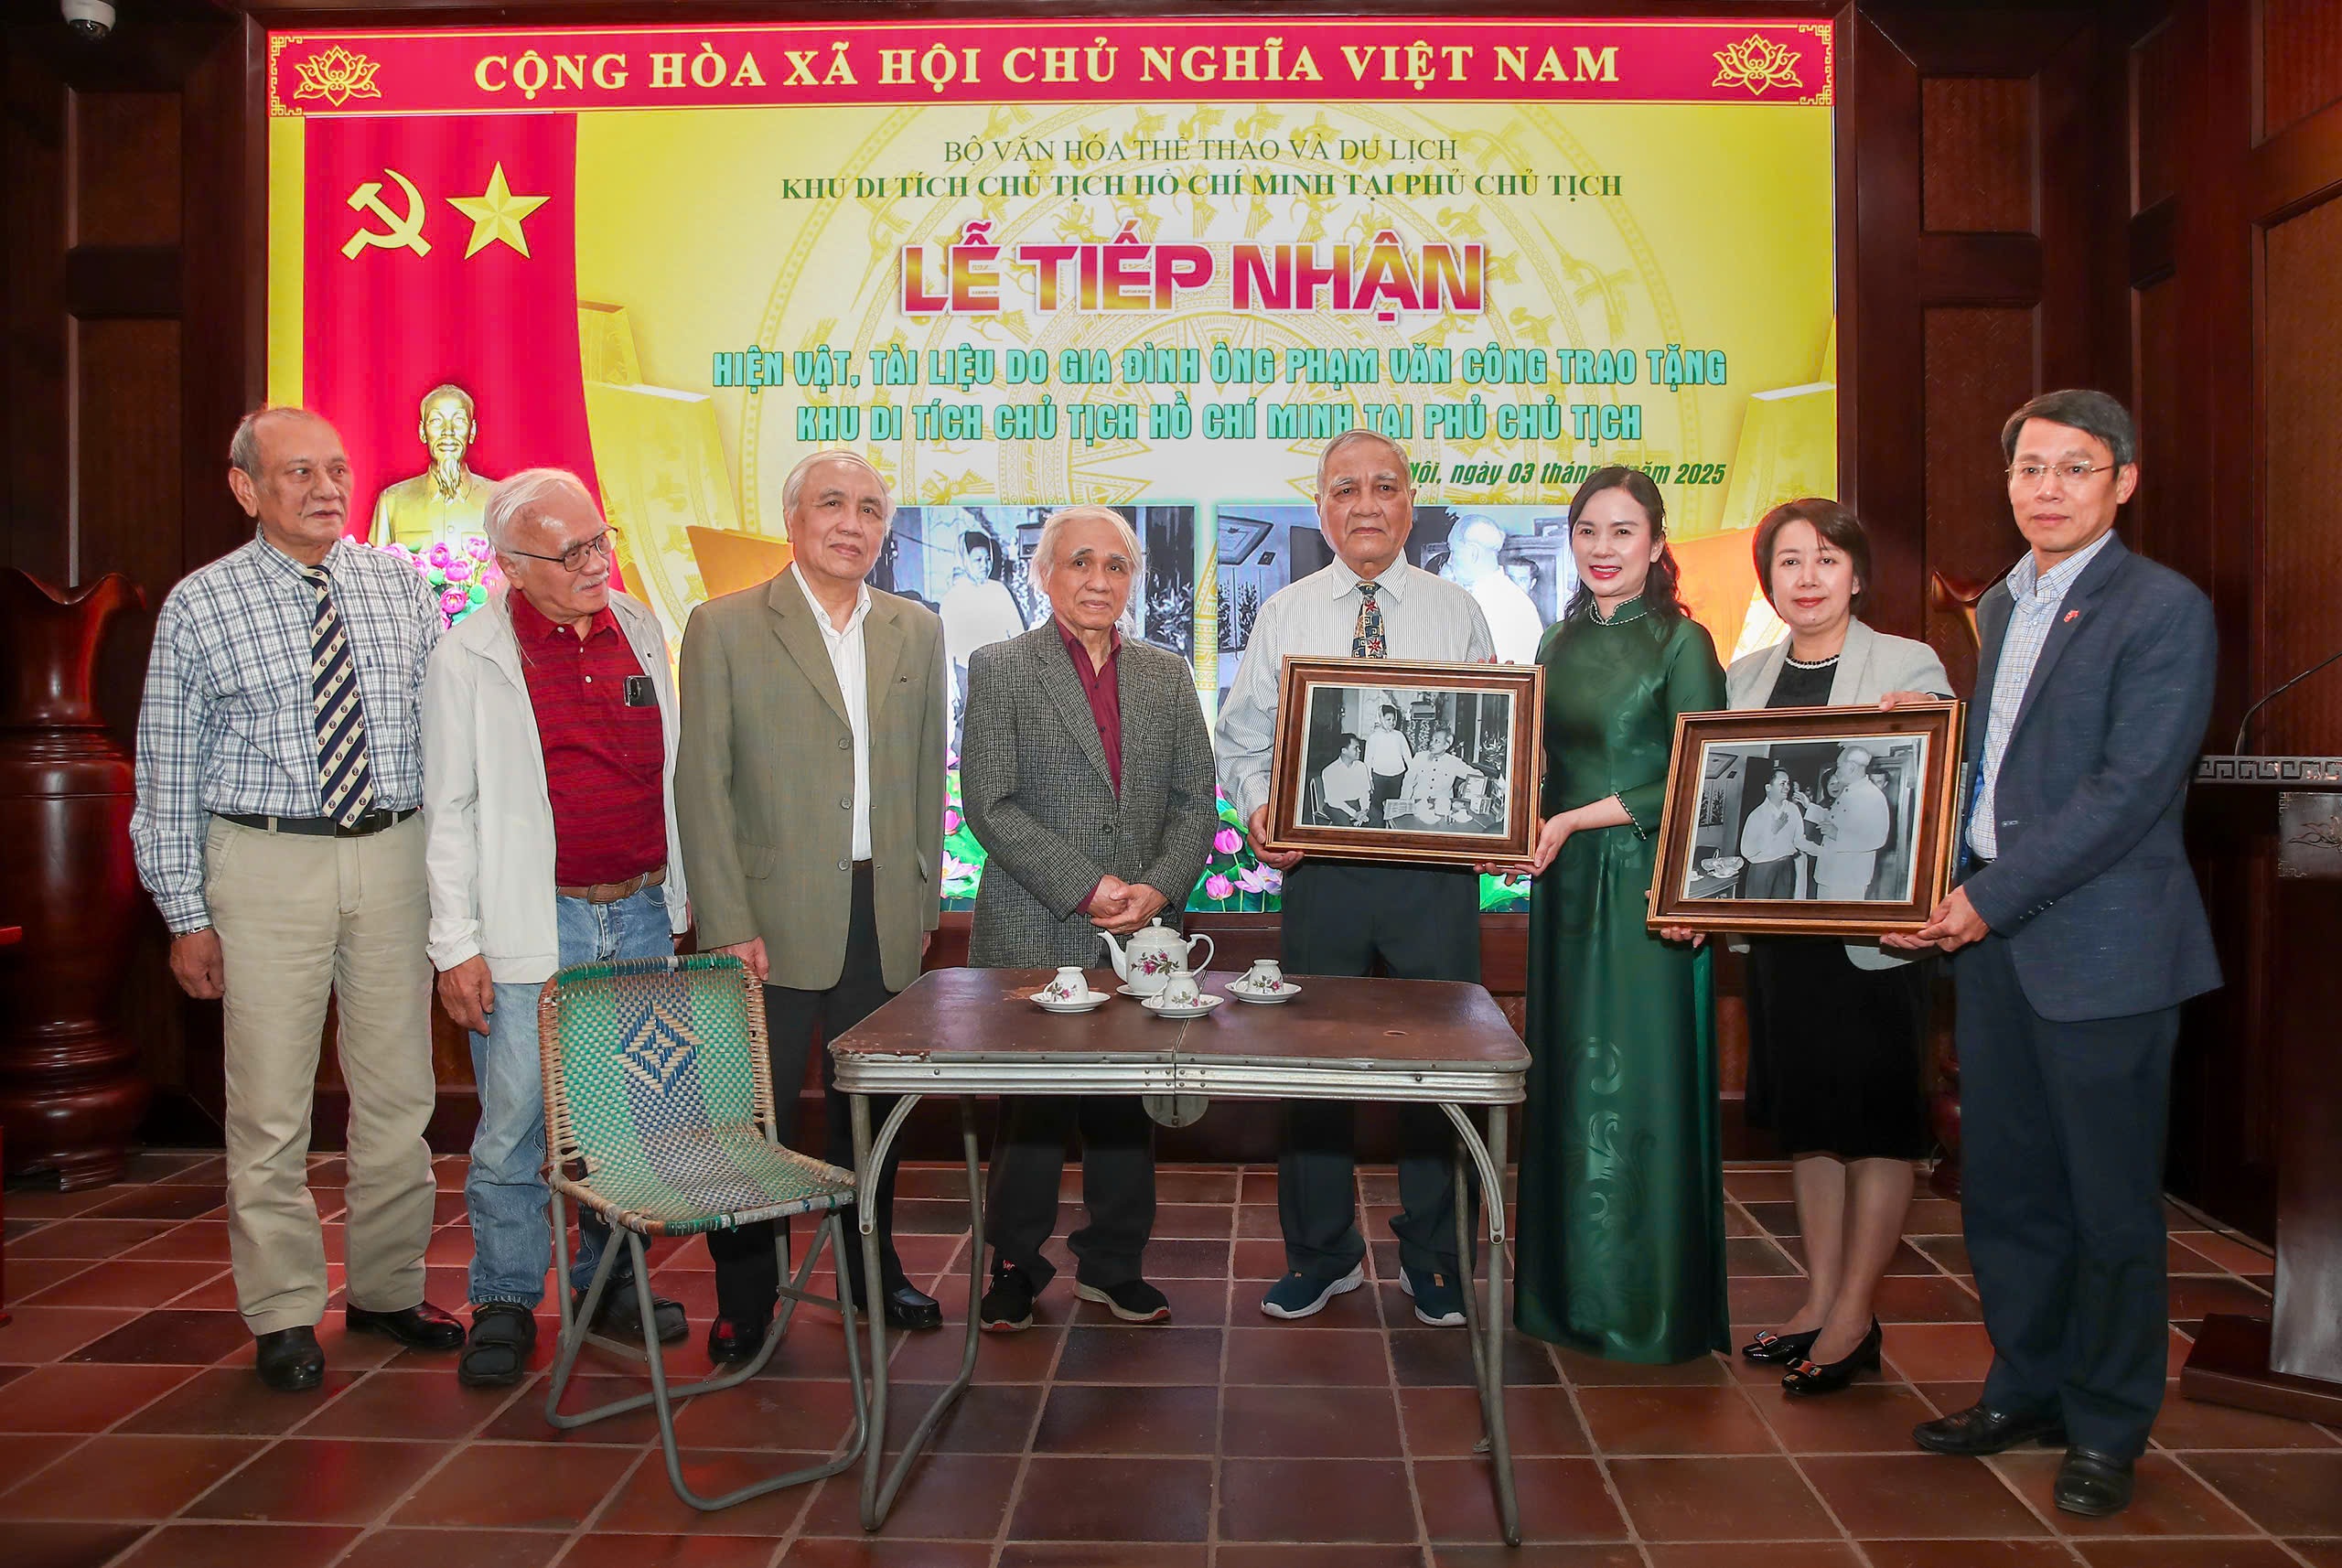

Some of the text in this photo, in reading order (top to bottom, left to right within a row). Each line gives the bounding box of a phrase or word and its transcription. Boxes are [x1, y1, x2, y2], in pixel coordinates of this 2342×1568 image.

[474, 37, 1620, 101] CỘNG HÒA XÃ HỘI CHỦ NGHĨA VIỆT NAM
[944, 134, 983, 166] BỘ
[993, 134, 1054, 162] VĂN
[1064, 134, 1127, 161] HÓA
[1198, 139, 1280, 161] THAO
[1289, 134, 1330, 161] VÀ
[1338, 139, 1380, 161] DU
[1389, 139, 1457, 165] LỊCH
[781, 168, 1623, 202] KHU DI TÍCH CHỦ TỊCH HỒ CHÍ MINH TẠI PHỦ CHỦ TỊCH
[903, 218, 1485, 323] LỄ TIẾP NHẬN
[712, 341, 1728, 394] HIỆN VẬT, TÀI LIỆU DO GIA ĐÌNH ÔNG PHẠM VĂN CÔNG TRAO TẶNG
[796, 404, 861, 442] KHU
[870, 404, 904, 441] DI
[912, 397, 983, 441] TÍCH
[994, 394, 1058, 440] CHỦ
[1067, 403, 1138, 446] TỊCH
[1149, 391, 1193, 440] HỒ
[1201, 397, 1256, 440] CHÍ
[1267, 403, 1354, 440] MINH
[1423, 393, 1487, 440] PHỦ
[1497, 393, 1563, 440] CHỦ
[1571, 403, 1641, 446] TỊCH
[1449, 460, 1503, 486] ngày
[1507, 462, 1536, 484] 03
[1628, 460, 1671, 485] ăm
[1674, 463, 1727, 485] 2025
